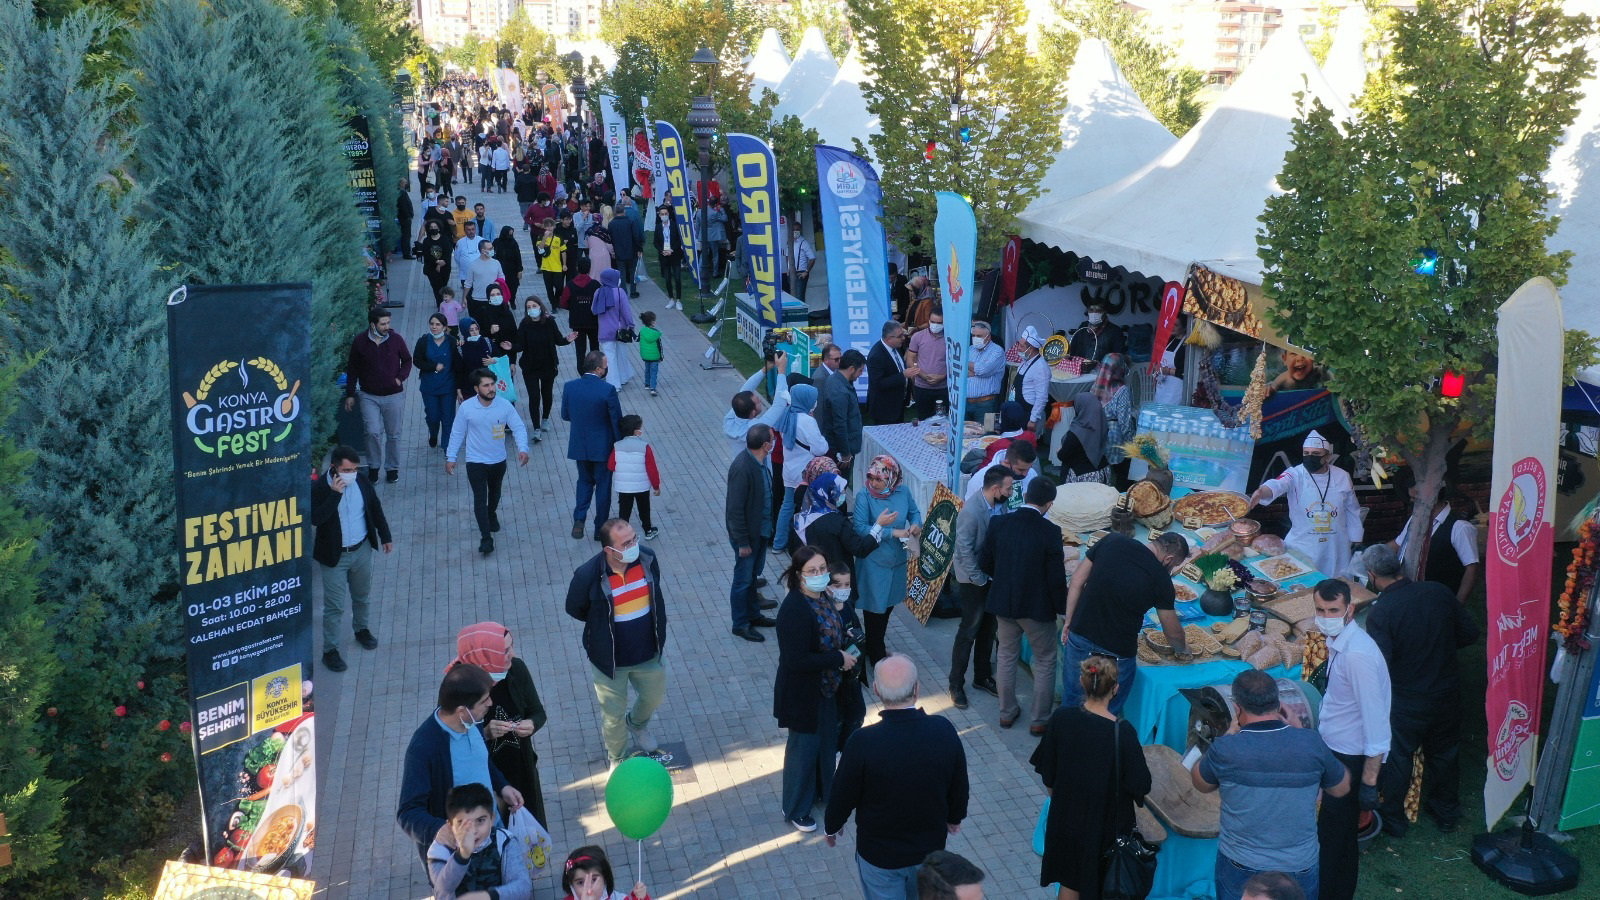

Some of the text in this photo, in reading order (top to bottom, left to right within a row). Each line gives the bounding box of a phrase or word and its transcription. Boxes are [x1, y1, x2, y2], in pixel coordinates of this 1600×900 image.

[187, 393, 300, 434] GASTRO
[218, 391, 268, 408] KONYA
[185, 496, 303, 548] FESTİVAL
[927, 523, 944, 548] 700
[186, 526, 303, 585] ZAMANI
[188, 576, 301, 617] 01-03 EKİM 2021
[201, 615, 227, 627] Saat:
[229, 604, 256, 619] 10.00
[264, 594, 291, 609] 22.00
[236, 617, 265, 631] ECDAT
[266, 603, 301, 623] BAHÇESİ
[198, 697, 245, 726] BENİM
[266, 697, 288, 709] KONYA
[198, 711, 246, 740] ŞEHRİM
